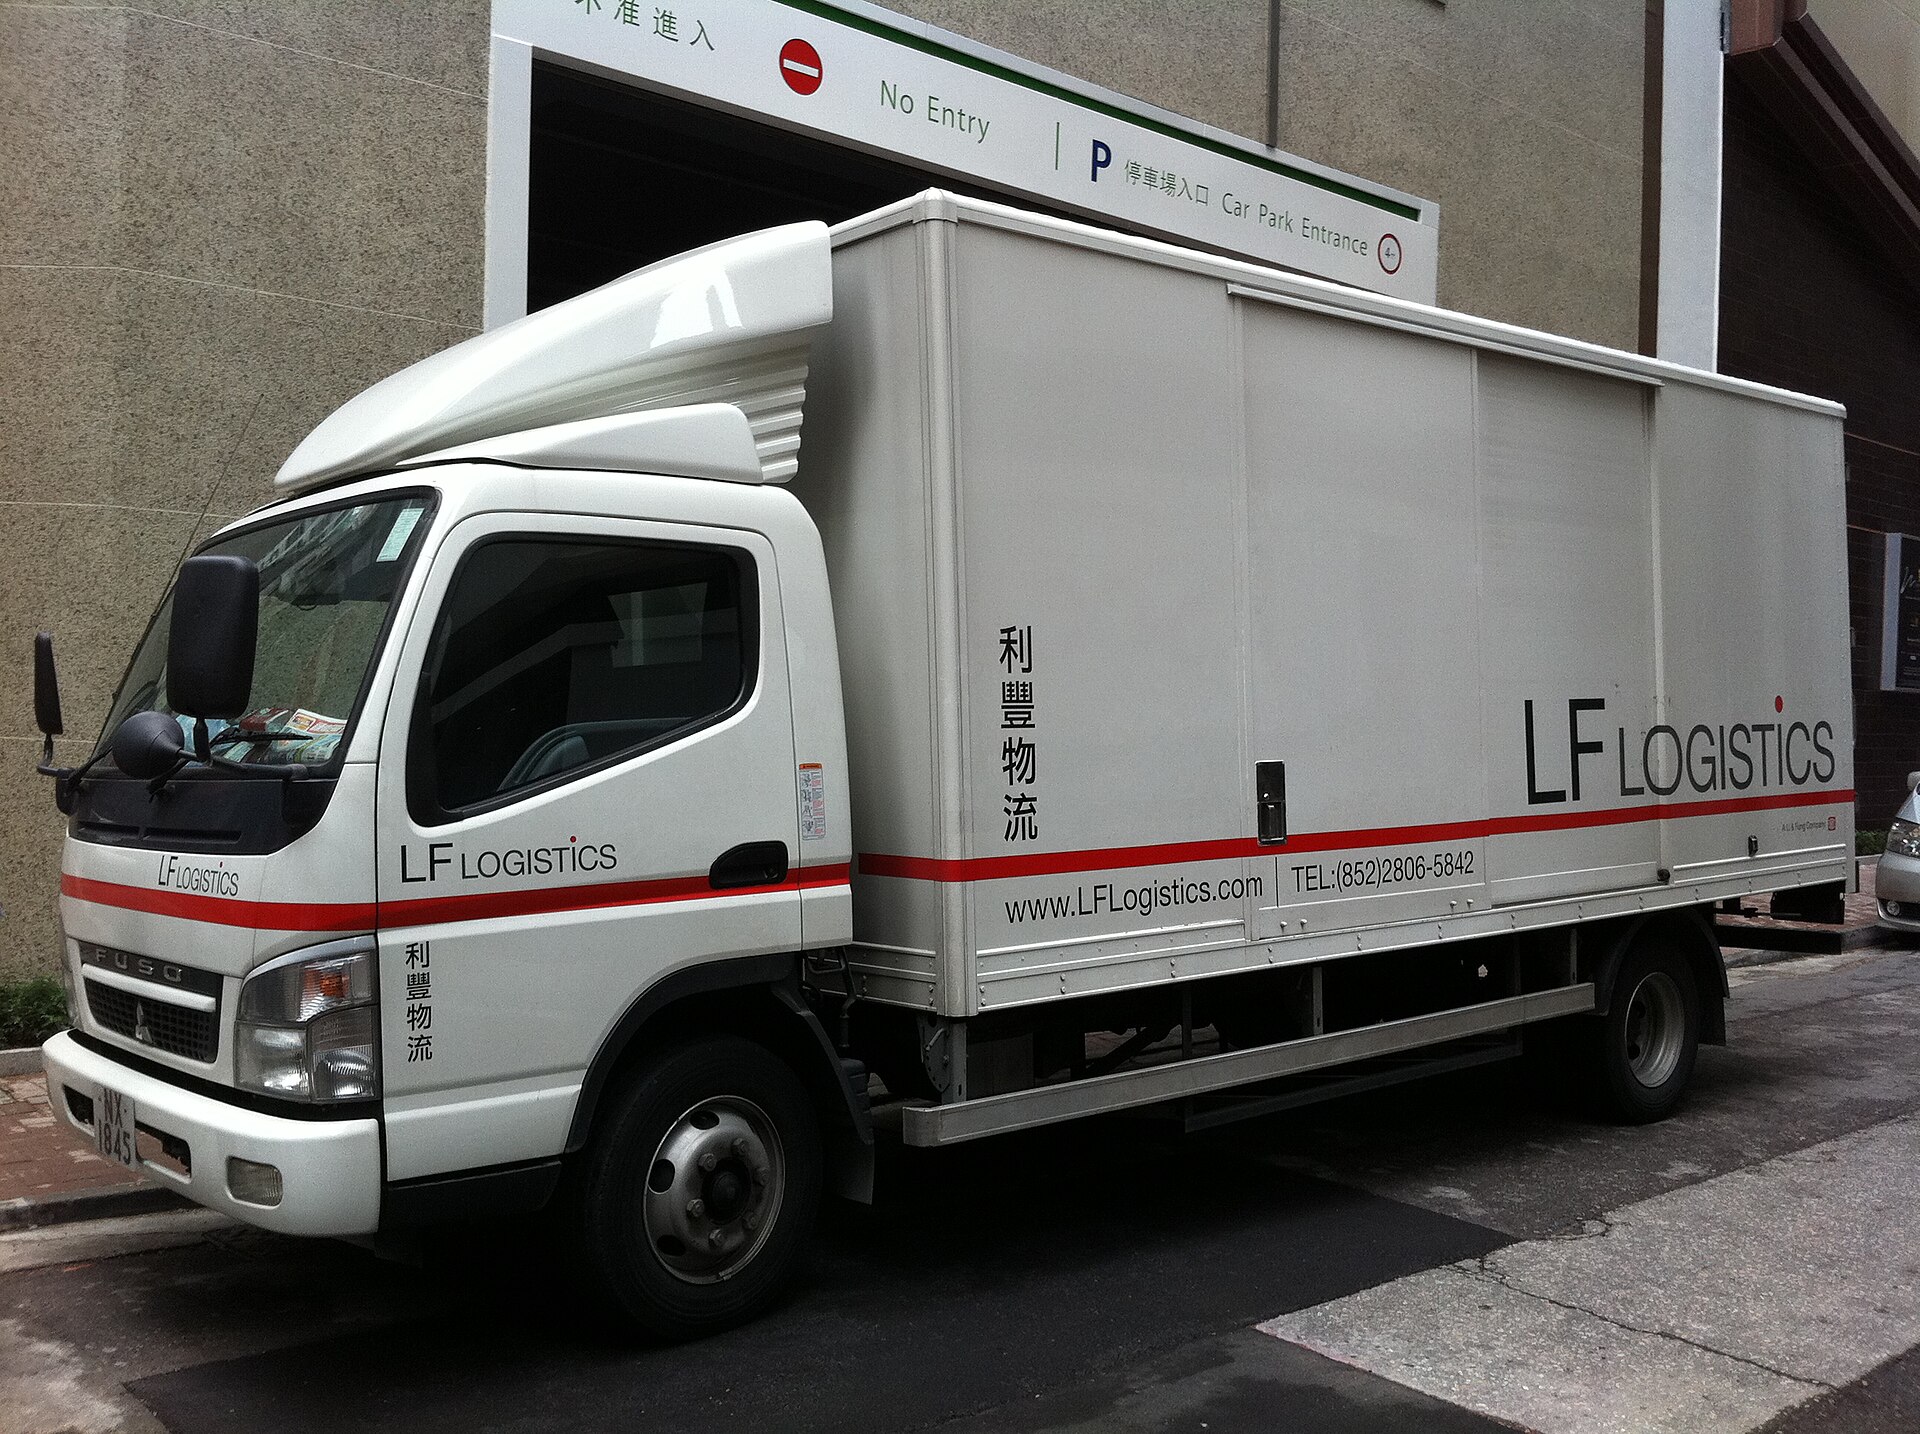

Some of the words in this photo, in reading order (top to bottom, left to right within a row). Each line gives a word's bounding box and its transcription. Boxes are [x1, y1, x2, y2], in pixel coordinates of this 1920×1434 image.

[880, 80, 914, 114] No
[927, 95, 990, 144] Entry
[1091, 138, 1112, 182] P
[1124, 159, 1209, 206] 停車場入口
[1222, 192, 1250, 219] Car
[1258, 203, 1294, 233] Park
[1301, 217, 1368, 256] Entrance
[999, 625, 1039, 842] 利豐物流
[1524, 698, 1606, 805] LF
[158, 855, 178, 887] LF
[400, 842, 454, 884] LF
[1291, 850, 1475, 894] TEL:(852)2806-5842
[1005, 875, 1264, 924] www.LFLogistics.com
[96, 948, 182, 982] FUSO
[405, 941, 433, 1063] 利豐物流
[98, 1120, 131, 1165] 1845
